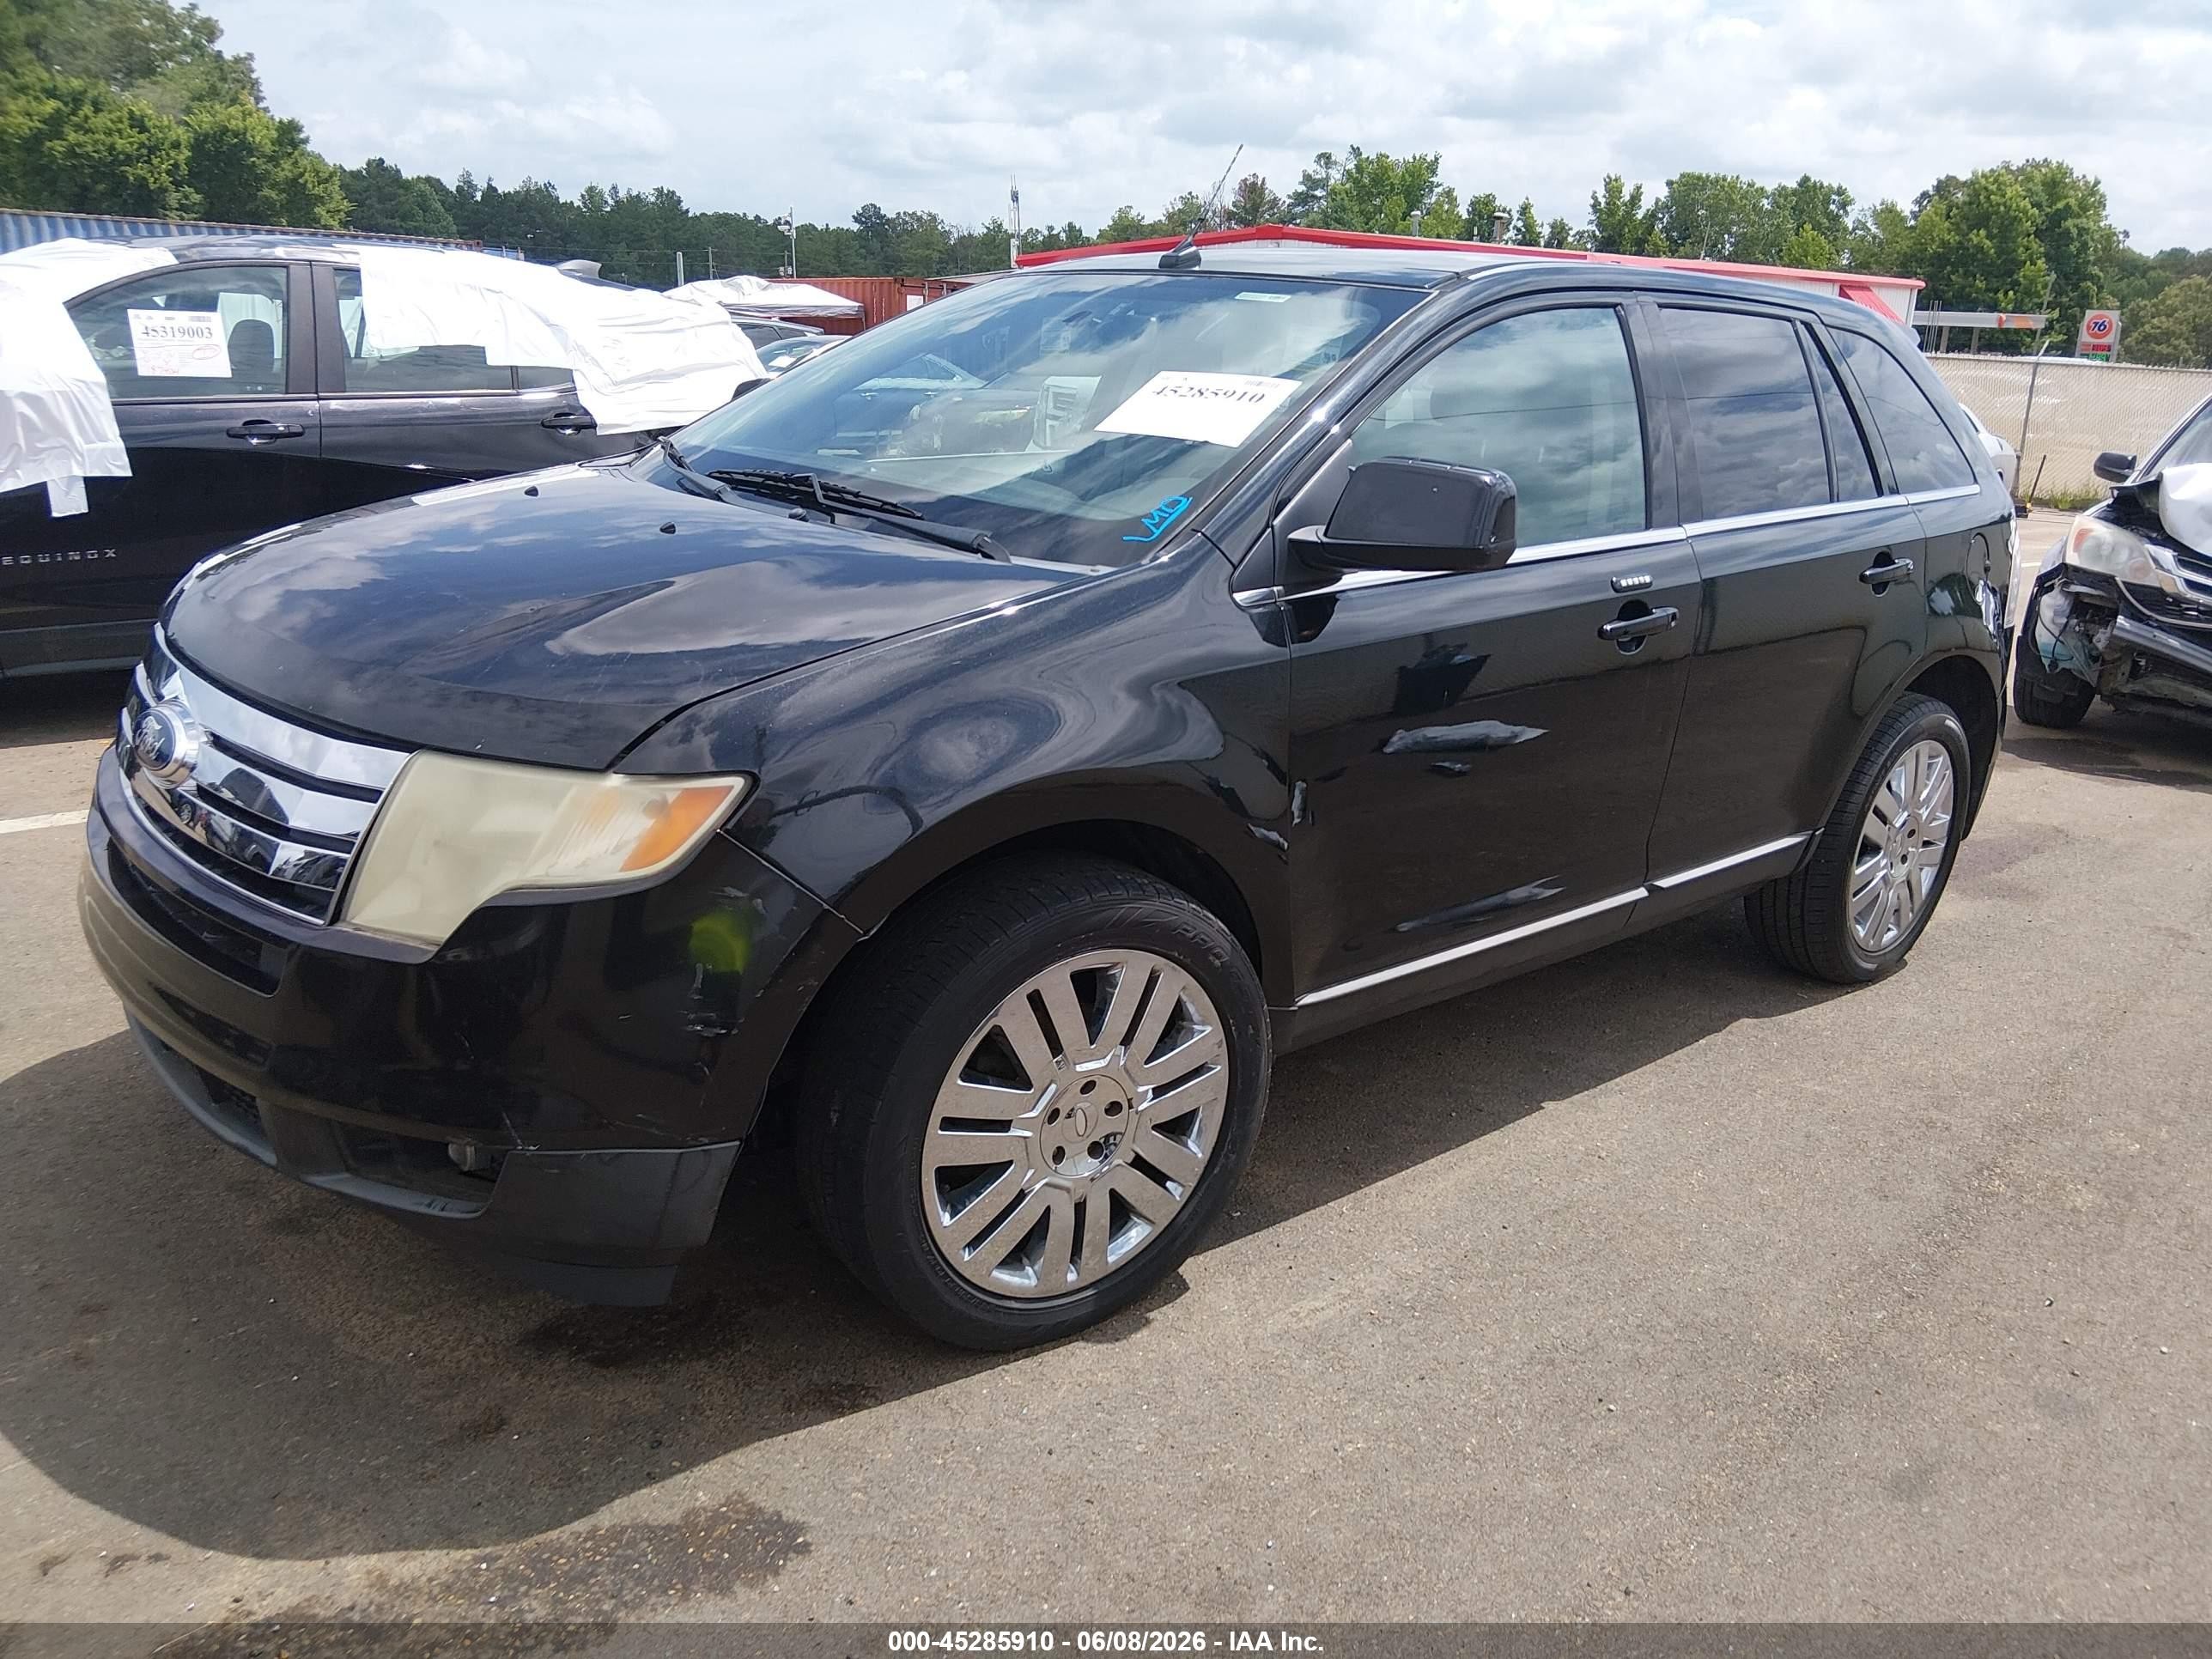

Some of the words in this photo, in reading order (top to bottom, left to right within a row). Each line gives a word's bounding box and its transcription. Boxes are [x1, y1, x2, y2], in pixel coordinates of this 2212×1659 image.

[141, 325, 214, 340] 45319003
[2089, 319, 2110, 333] 76
[1152, 385, 1267, 404] 45285910
[1, 548, 118, 567] EQUINOX
[136, 715, 166, 760] Ford
